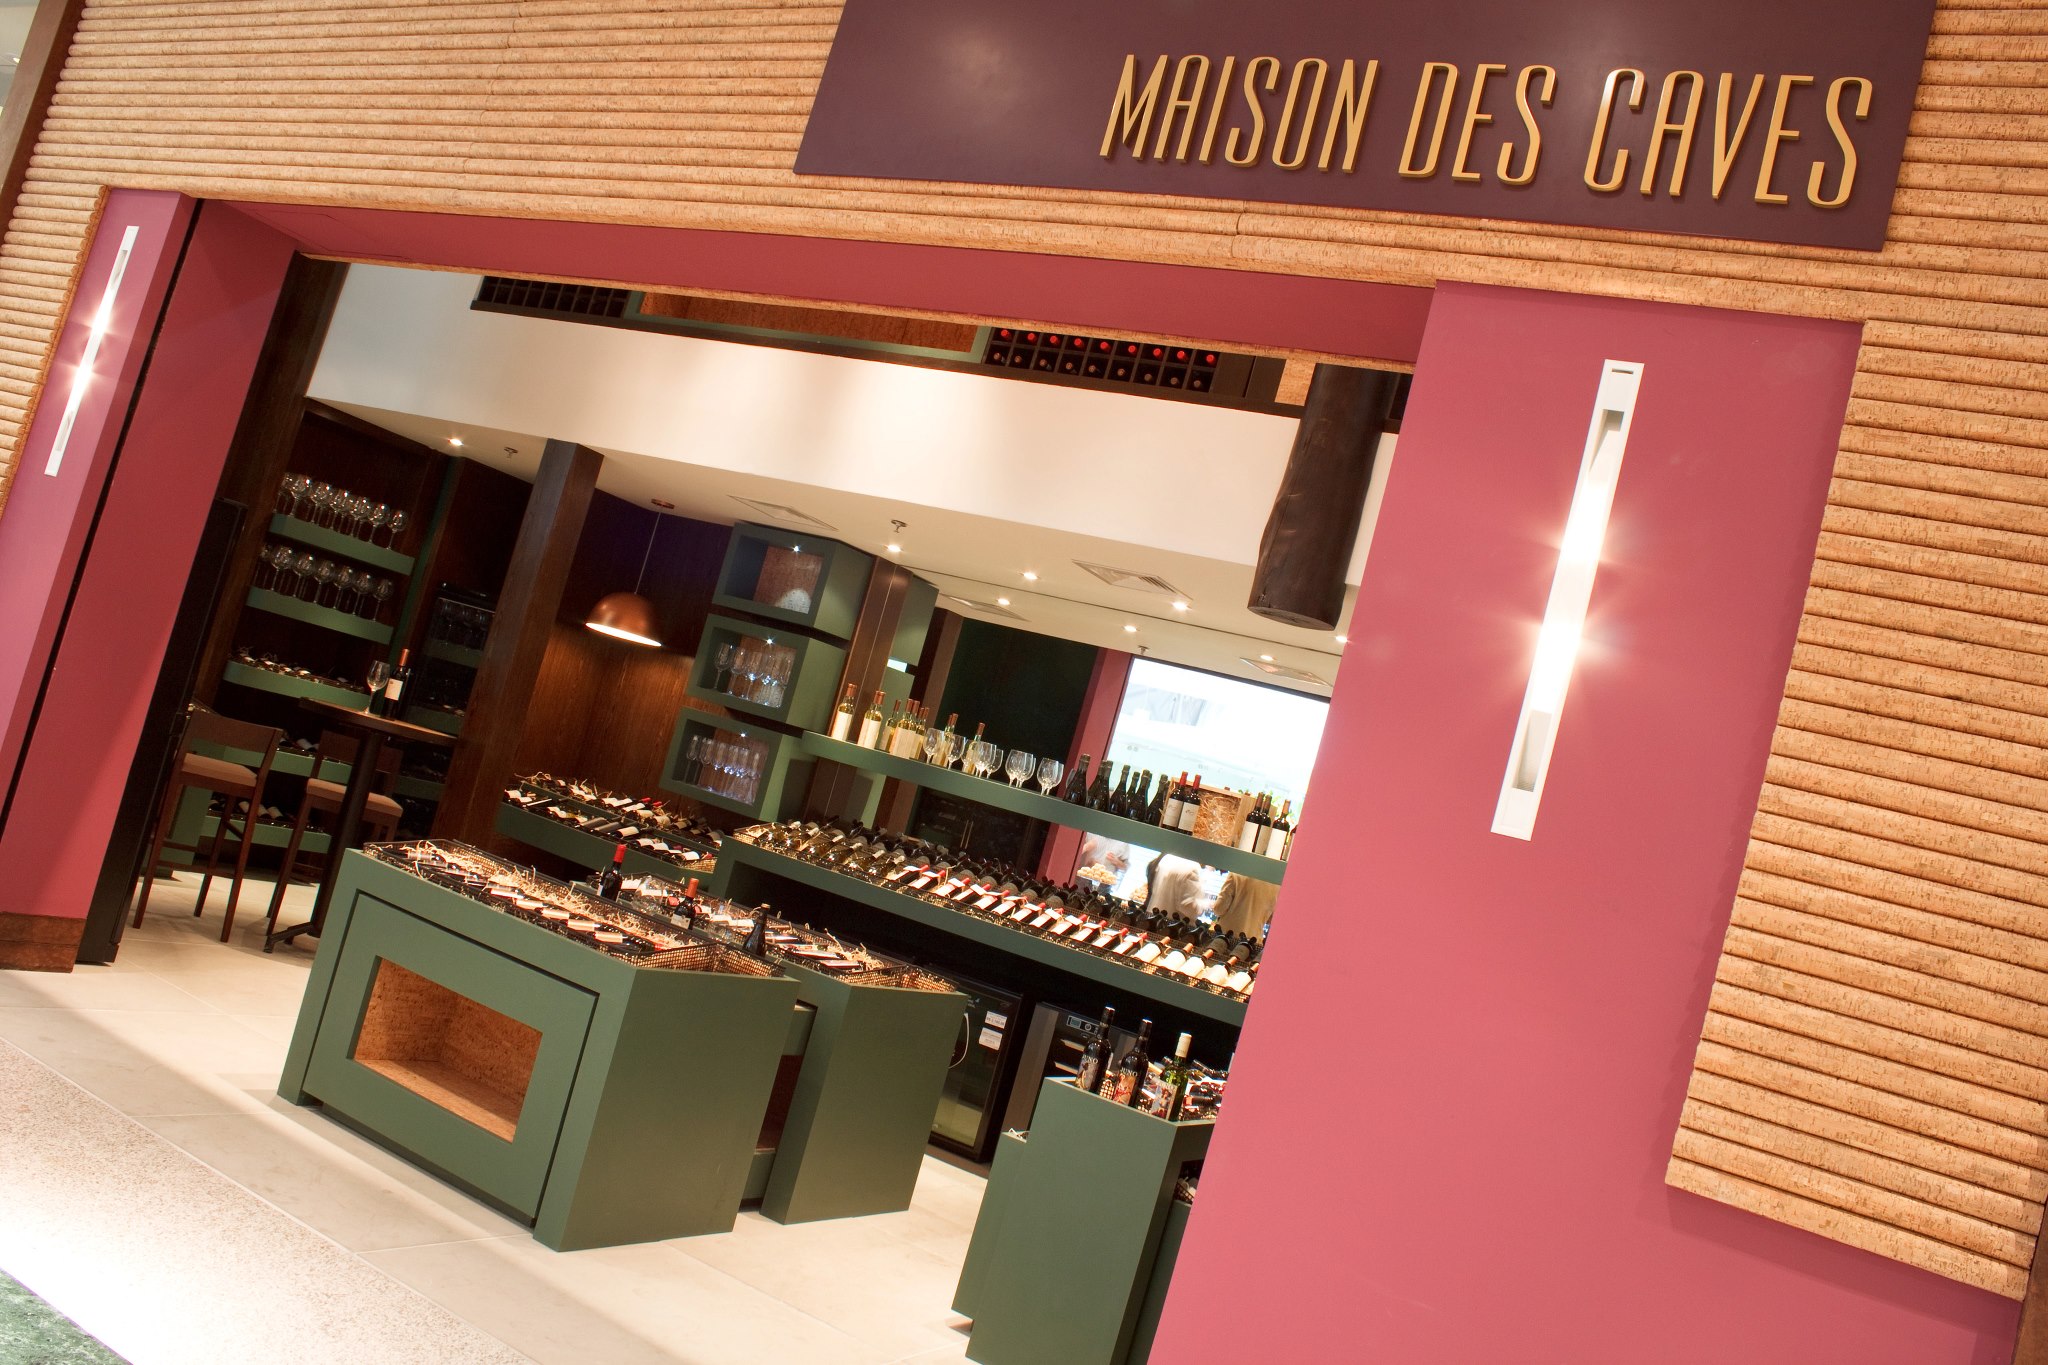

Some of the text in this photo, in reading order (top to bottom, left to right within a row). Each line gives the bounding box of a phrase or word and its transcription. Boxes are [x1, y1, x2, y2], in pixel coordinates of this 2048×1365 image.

[1099, 54, 1875, 208] MAISON DES CAVES
[1120, 1066, 1137, 1077] JUNO
